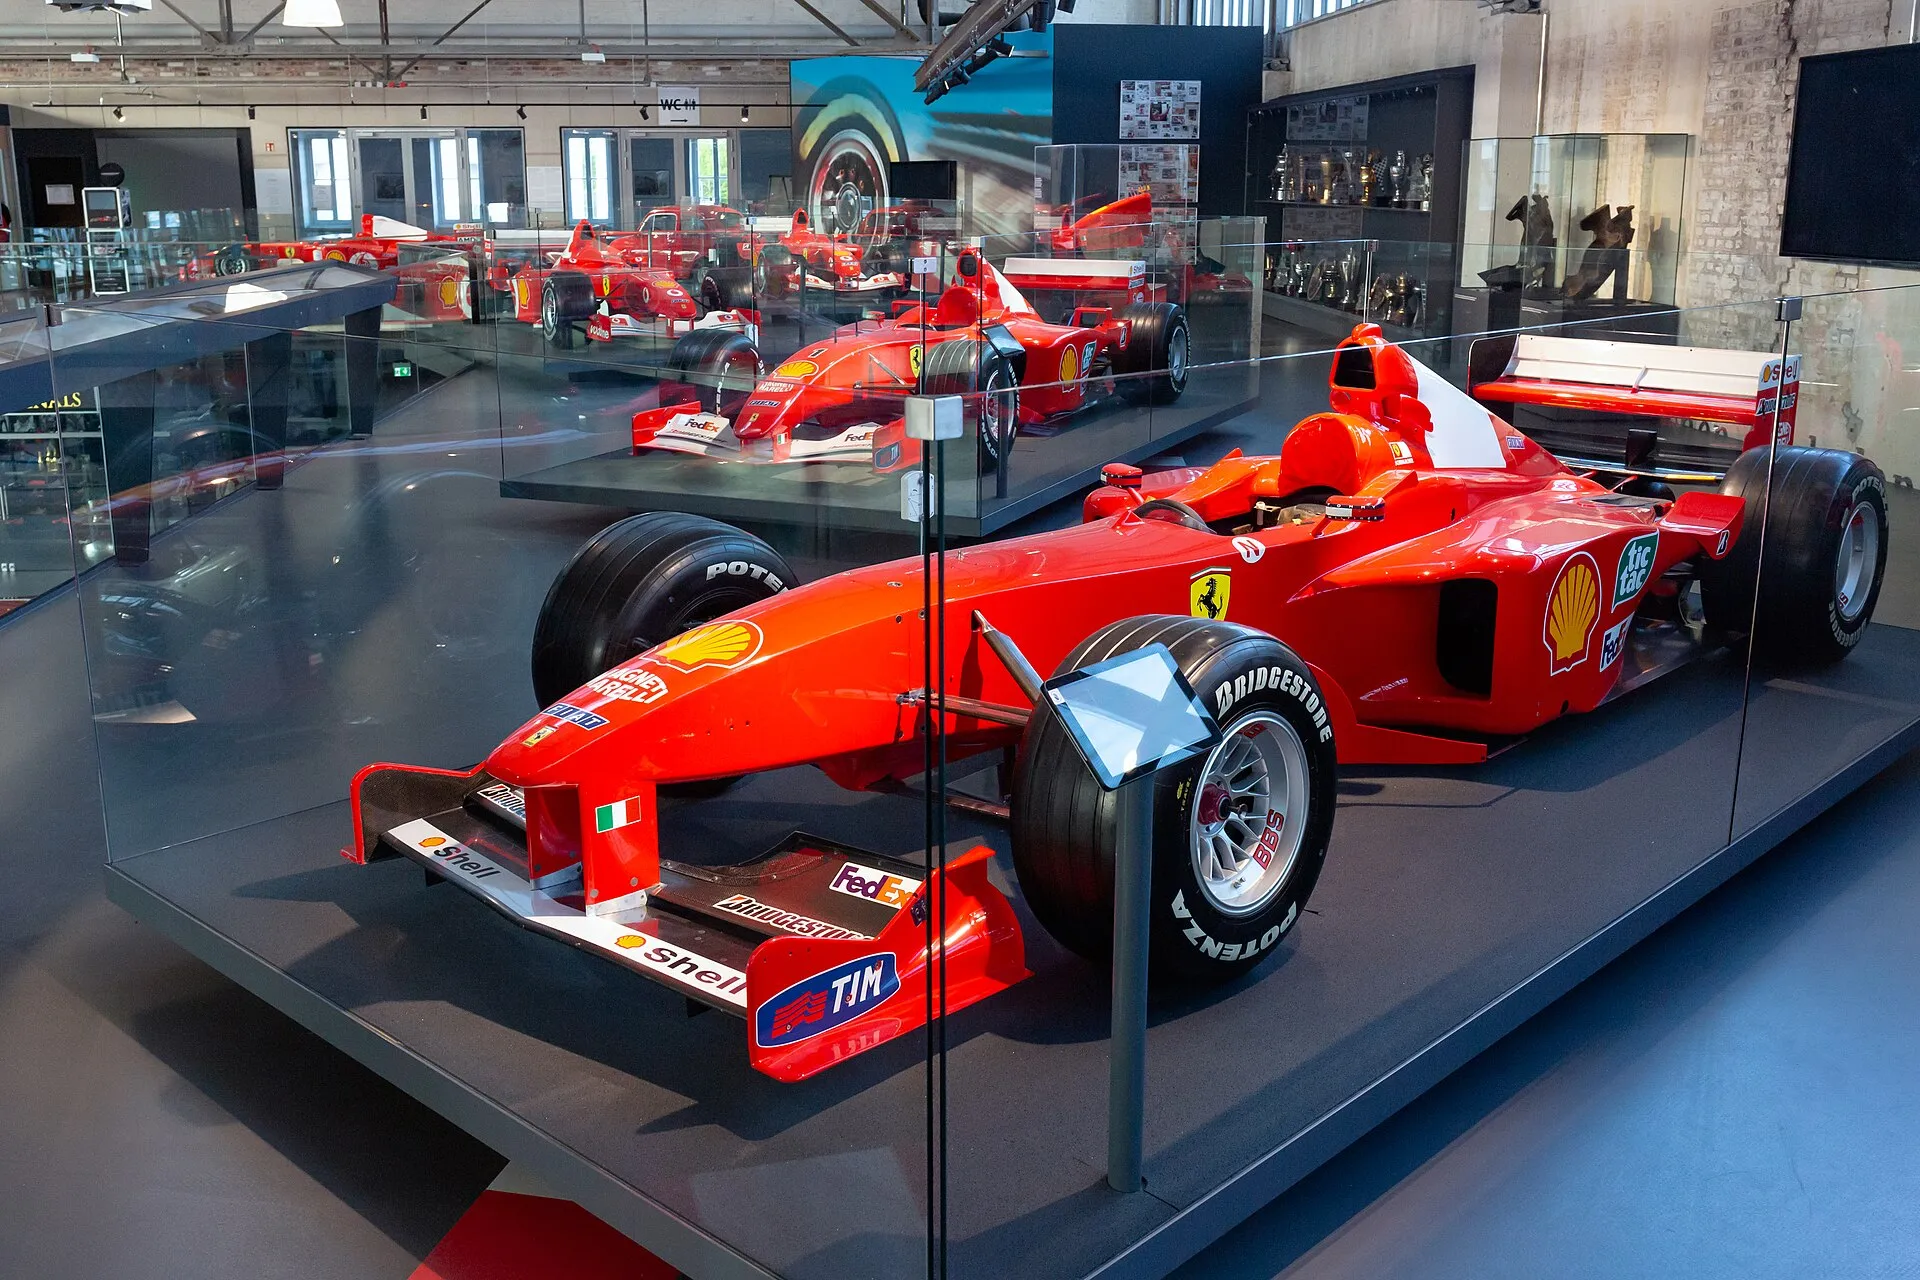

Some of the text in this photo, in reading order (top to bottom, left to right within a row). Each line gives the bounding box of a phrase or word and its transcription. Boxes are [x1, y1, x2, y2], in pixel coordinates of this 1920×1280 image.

[661, 98, 681, 110] WC
[1772, 360, 1798, 380] Sell
[685, 418, 720, 433] FedEx
[844, 431, 873, 442] FedE
[1628, 541, 1651, 572] tic
[706, 560, 790, 595] POTE
[1620, 565, 1646, 596] tac
[546, 703, 603, 728] FIAT
[1215, 666, 1333, 744] BRIDGESTONE
[1252, 808, 1285, 870] BBS
[433, 846, 502, 880] Shell
[833, 865, 913, 907] FedEx
[1171, 889, 1297, 962] POTENZA
[644, 947, 747, 995] Shell
[831, 960, 884, 1014] TIM
